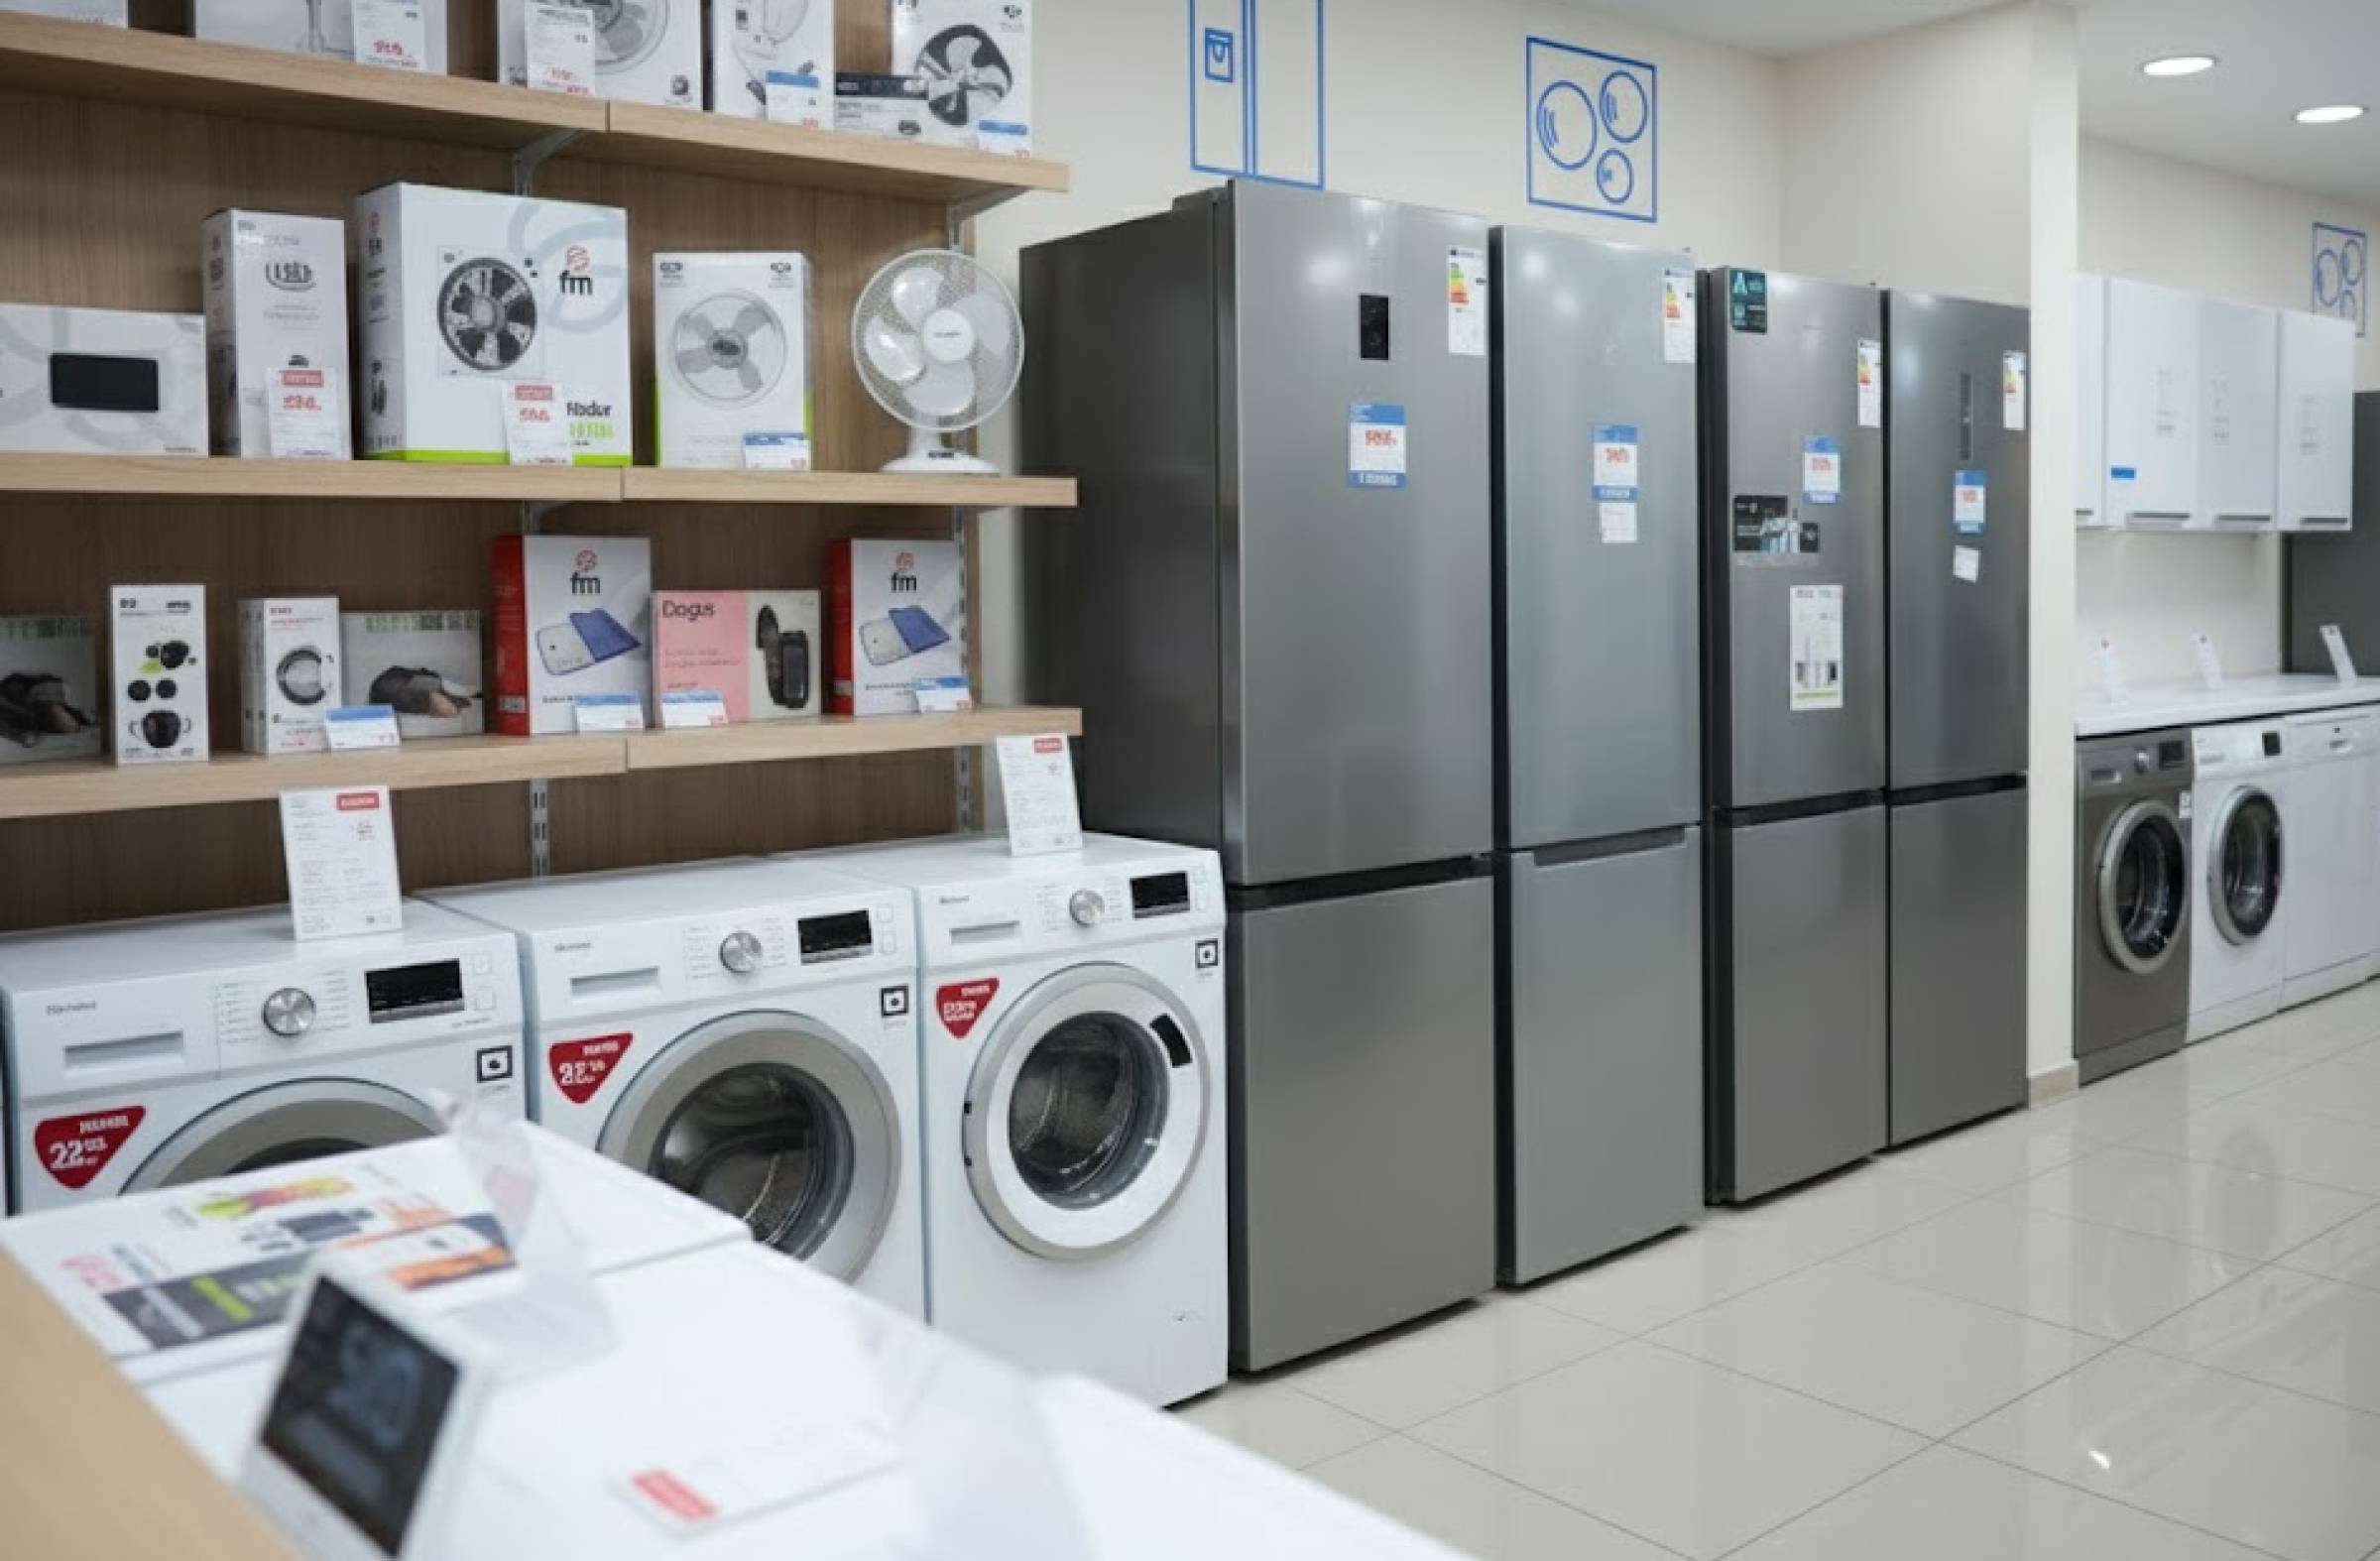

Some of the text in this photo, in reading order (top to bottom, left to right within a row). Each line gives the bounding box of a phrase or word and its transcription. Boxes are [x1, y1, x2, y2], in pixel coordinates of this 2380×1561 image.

[560, 270, 593, 295] fm
[570, 571, 601, 594] fm
[890, 571, 917, 593] fm
